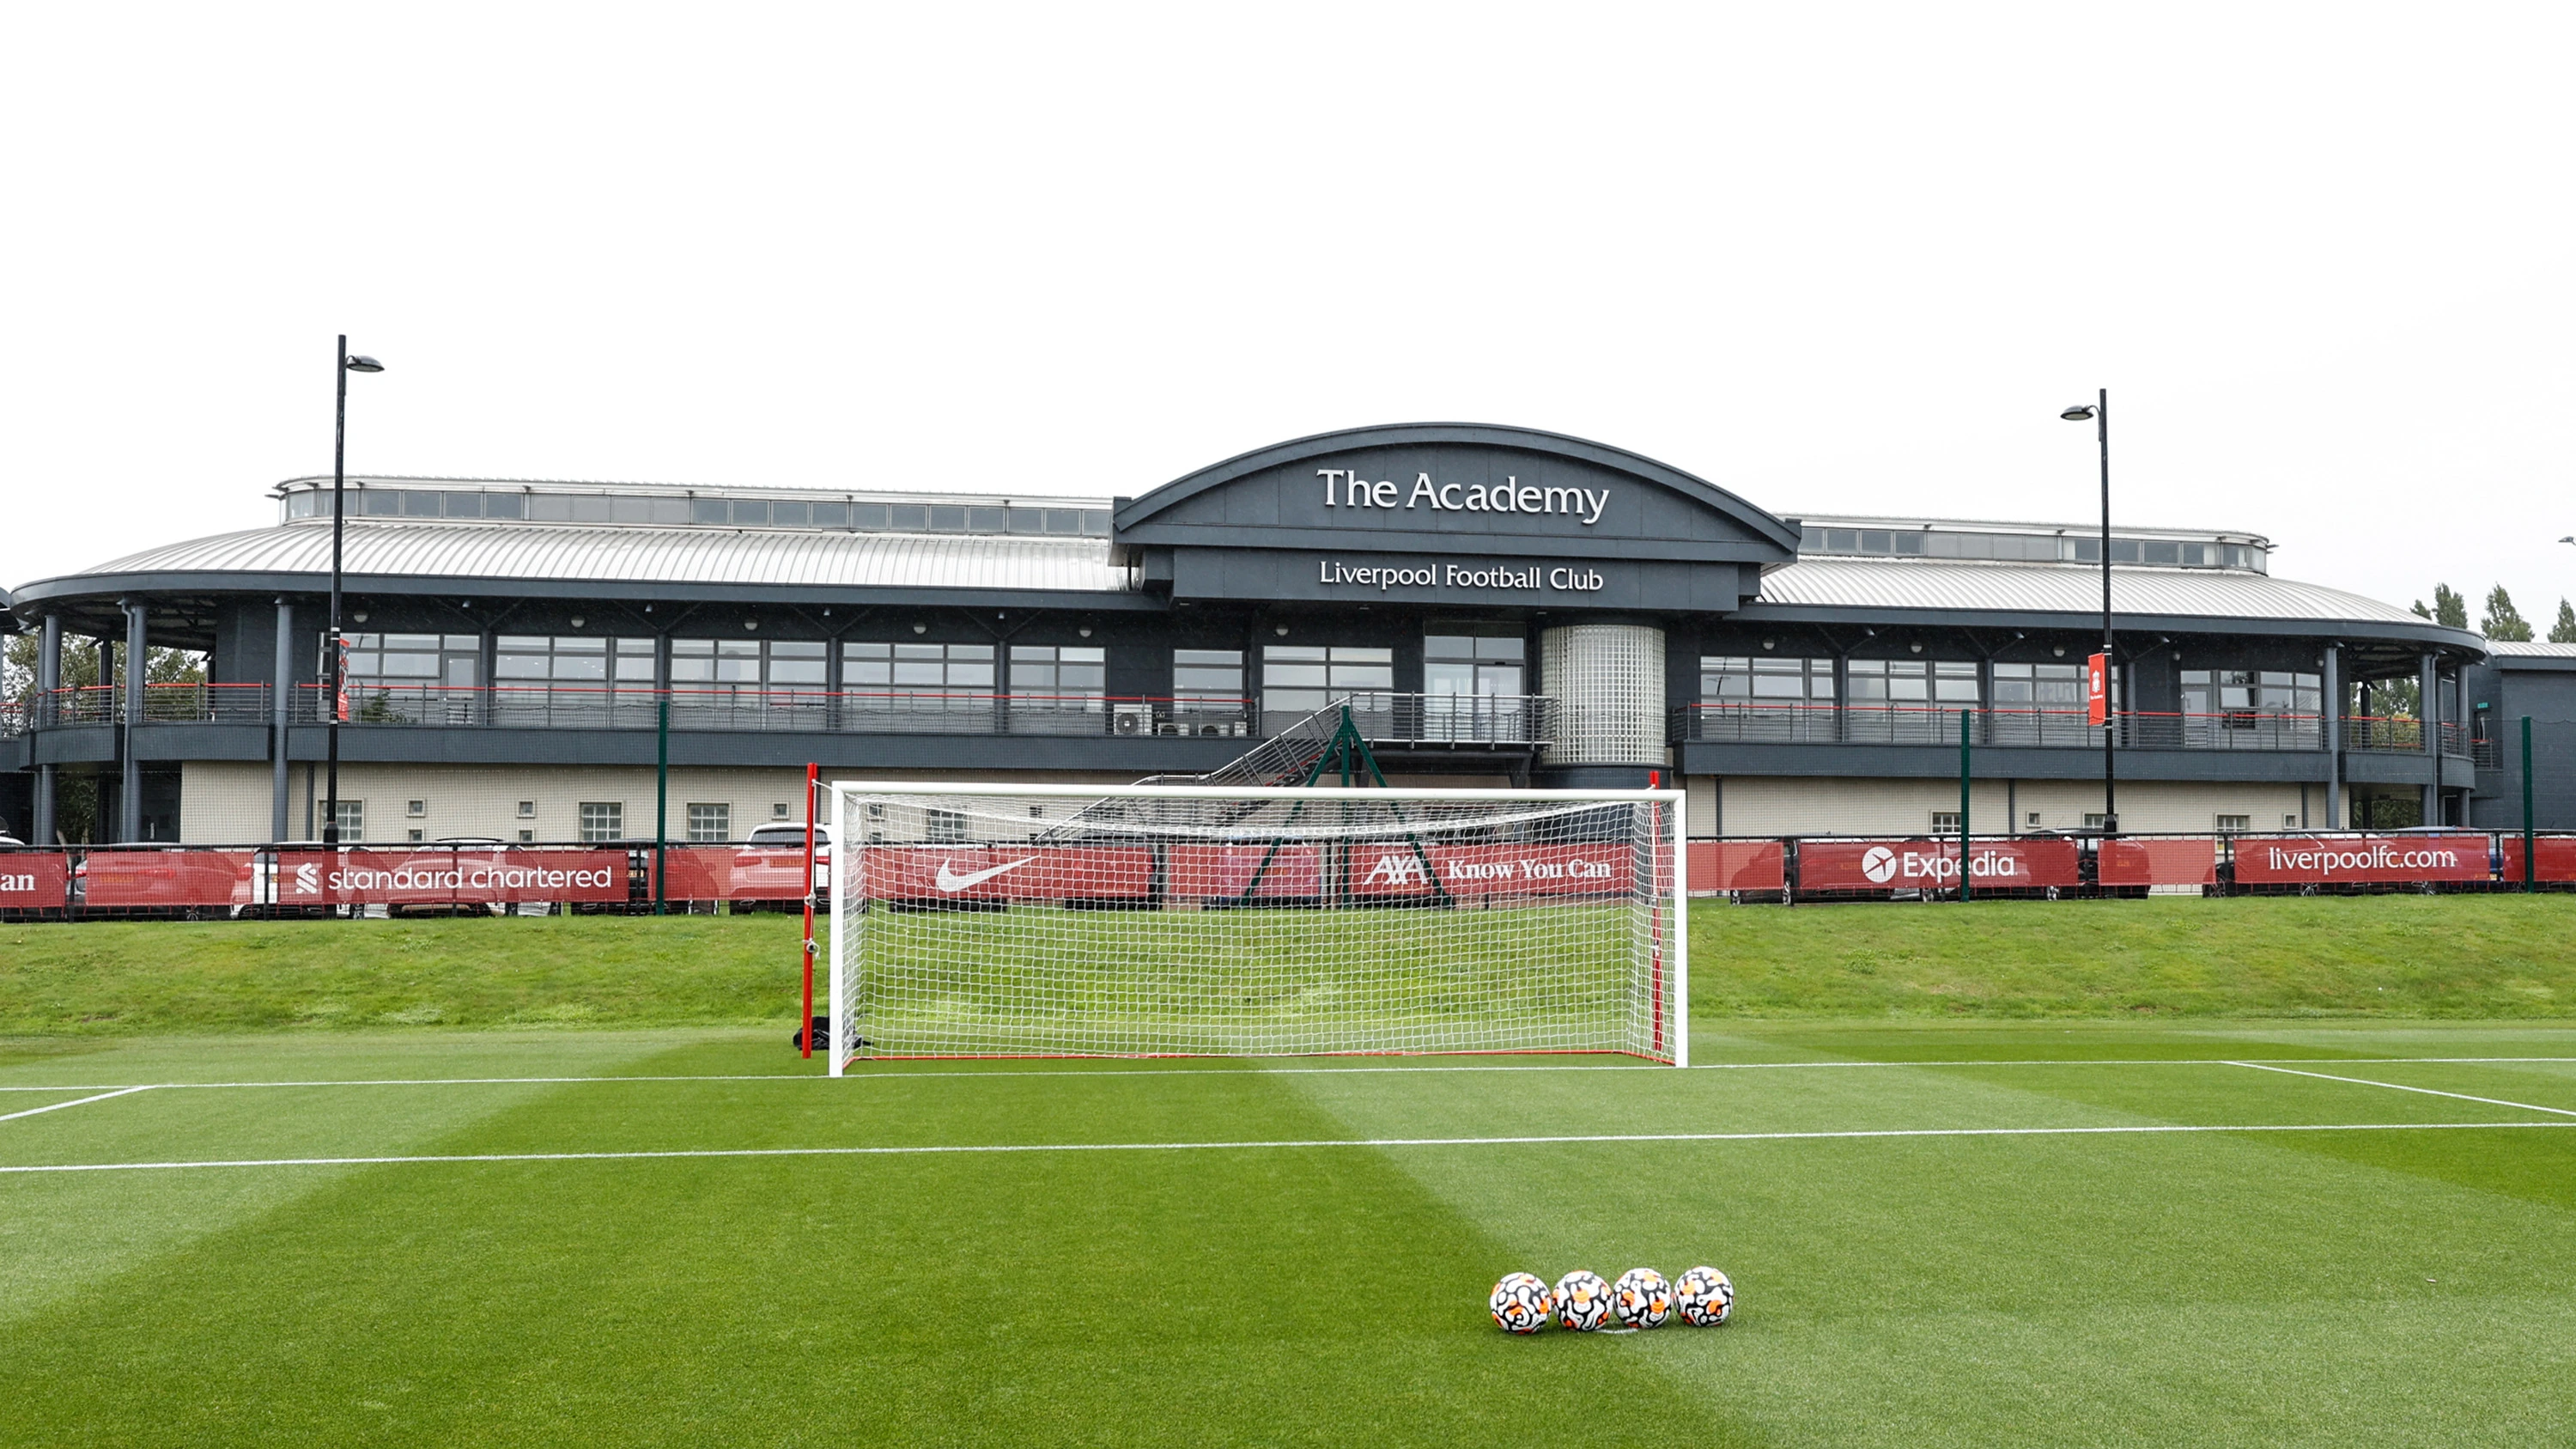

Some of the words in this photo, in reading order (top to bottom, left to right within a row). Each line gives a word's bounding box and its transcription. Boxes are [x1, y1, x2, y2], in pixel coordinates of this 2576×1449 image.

[1316, 469, 1398, 508] The
[1406, 472, 1610, 525] Academy
[1320, 562, 1437, 590] Liverpool
[1446, 564, 1540, 588] Football
[1549, 568, 1603, 590] Club
[1363, 855, 1428, 886] AXA
[1448, 860, 1514, 880] Know
[1520, 859, 1564, 880] You
[1568, 858, 1612, 878] Can
[2269, 846, 2457, 875] liverpoolfc.com
[0, 873, 35, 891] an
[328, 866, 463, 891] standard
[470, 865, 611, 888] chartered
